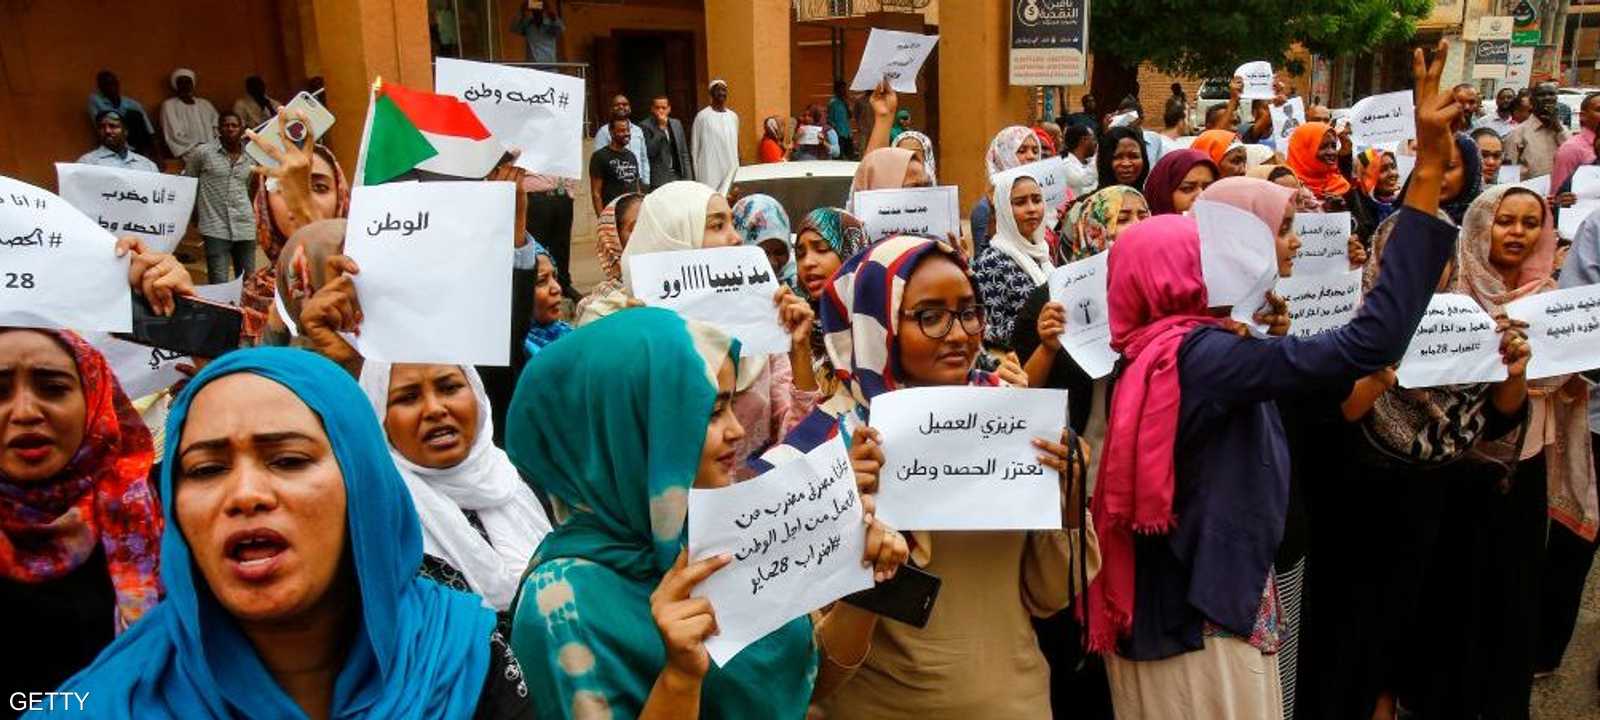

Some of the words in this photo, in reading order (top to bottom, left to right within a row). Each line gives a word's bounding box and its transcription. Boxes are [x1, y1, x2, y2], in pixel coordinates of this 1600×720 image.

[464, 83, 502, 104] وطن
[101, 189, 149, 204] مضرب
[98, 215, 119, 233] وط
[366, 210, 430, 236] الوطن
[5, 272, 36, 289] 28
[919, 411, 978, 435] العميل
[981, 415, 1028, 439] عزيزي
[896, 458, 939, 481] وطن
[943, 457, 997, 476] الحصه
[763, 491, 806, 517] مضرب
[831, 489, 856, 521] العمل
[781, 517, 802, 544] اجل
[804, 513, 830, 533] من
[734, 528, 778, 562] الوطن
